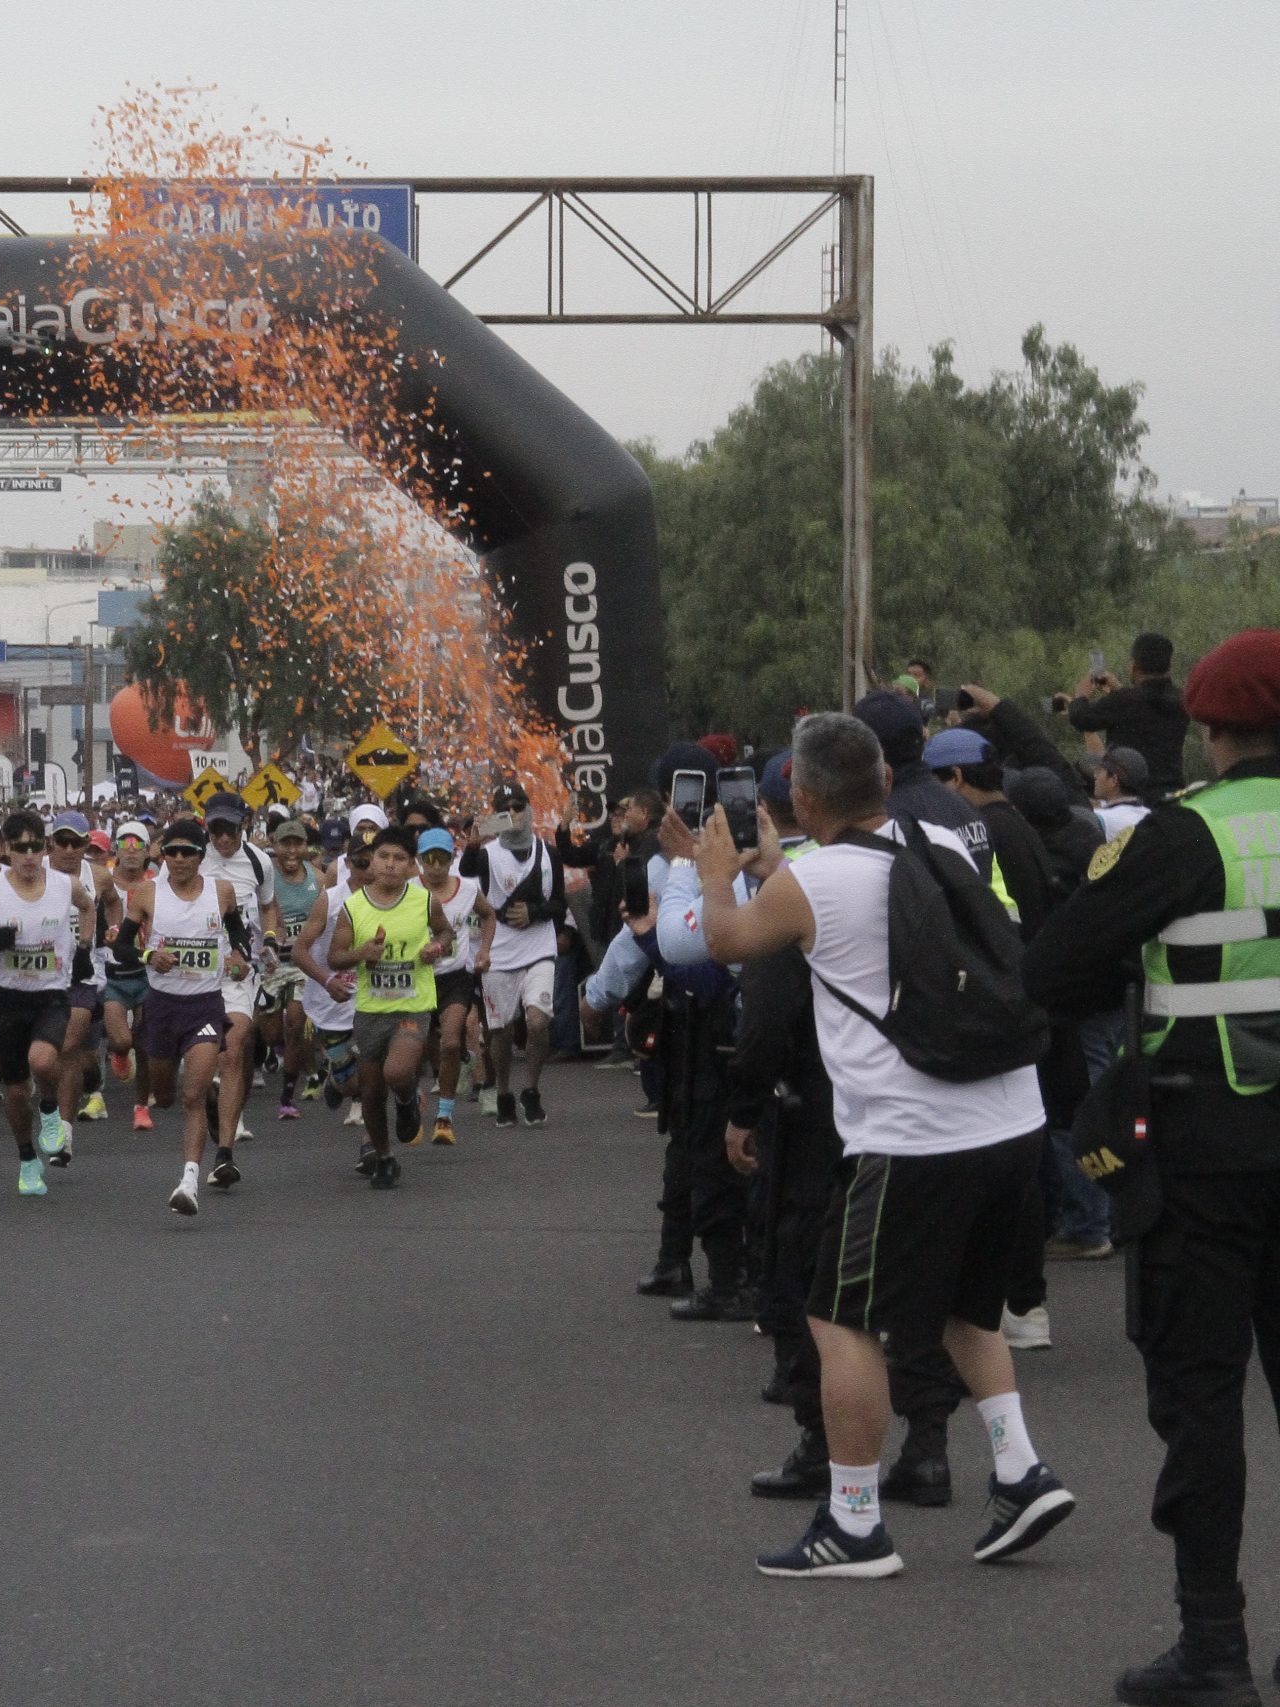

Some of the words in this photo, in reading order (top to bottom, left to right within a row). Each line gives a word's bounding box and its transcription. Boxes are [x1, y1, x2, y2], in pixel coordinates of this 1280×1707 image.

[306, 199, 382, 233] ALTO
[12, 480, 55, 489] INFINITE
[557, 562, 613, 832] CajaCusco
[195, 756, 208, 769] 10
[1228, 813, 1280, 856] PO
[13, 955, 48, 970] 120
[175, 951, 211, 968] 148
